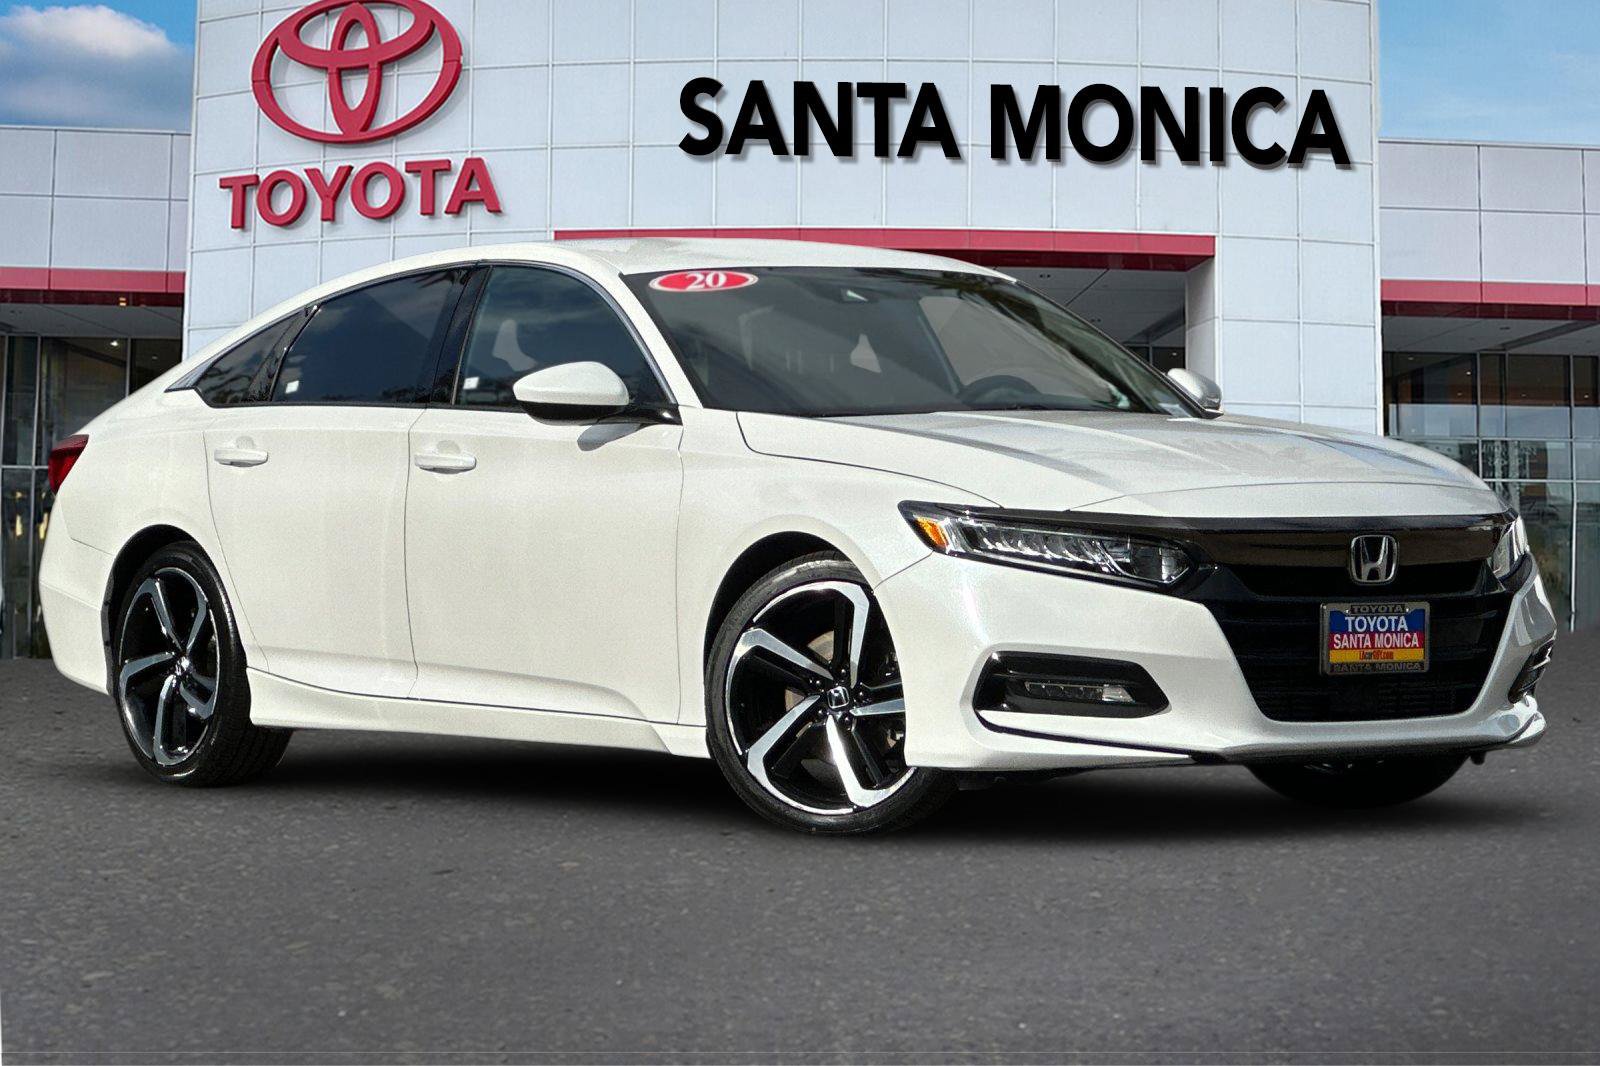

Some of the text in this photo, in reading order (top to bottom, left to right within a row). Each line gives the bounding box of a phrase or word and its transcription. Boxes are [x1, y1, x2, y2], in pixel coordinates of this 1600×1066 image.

[678, 76, 1352, 168] SANTA MONICA
[219, 157, 503, 229] TOYOTA
[686, 271, 727, 290] 20
[1352, 605, 1405, 613] TOYOTA
[1344, 616, 1409, 632] TOYOTA
[1333, 632, 1420, 649] SANTA MONICA
[1375, 662, 1421, 672] MONICA
